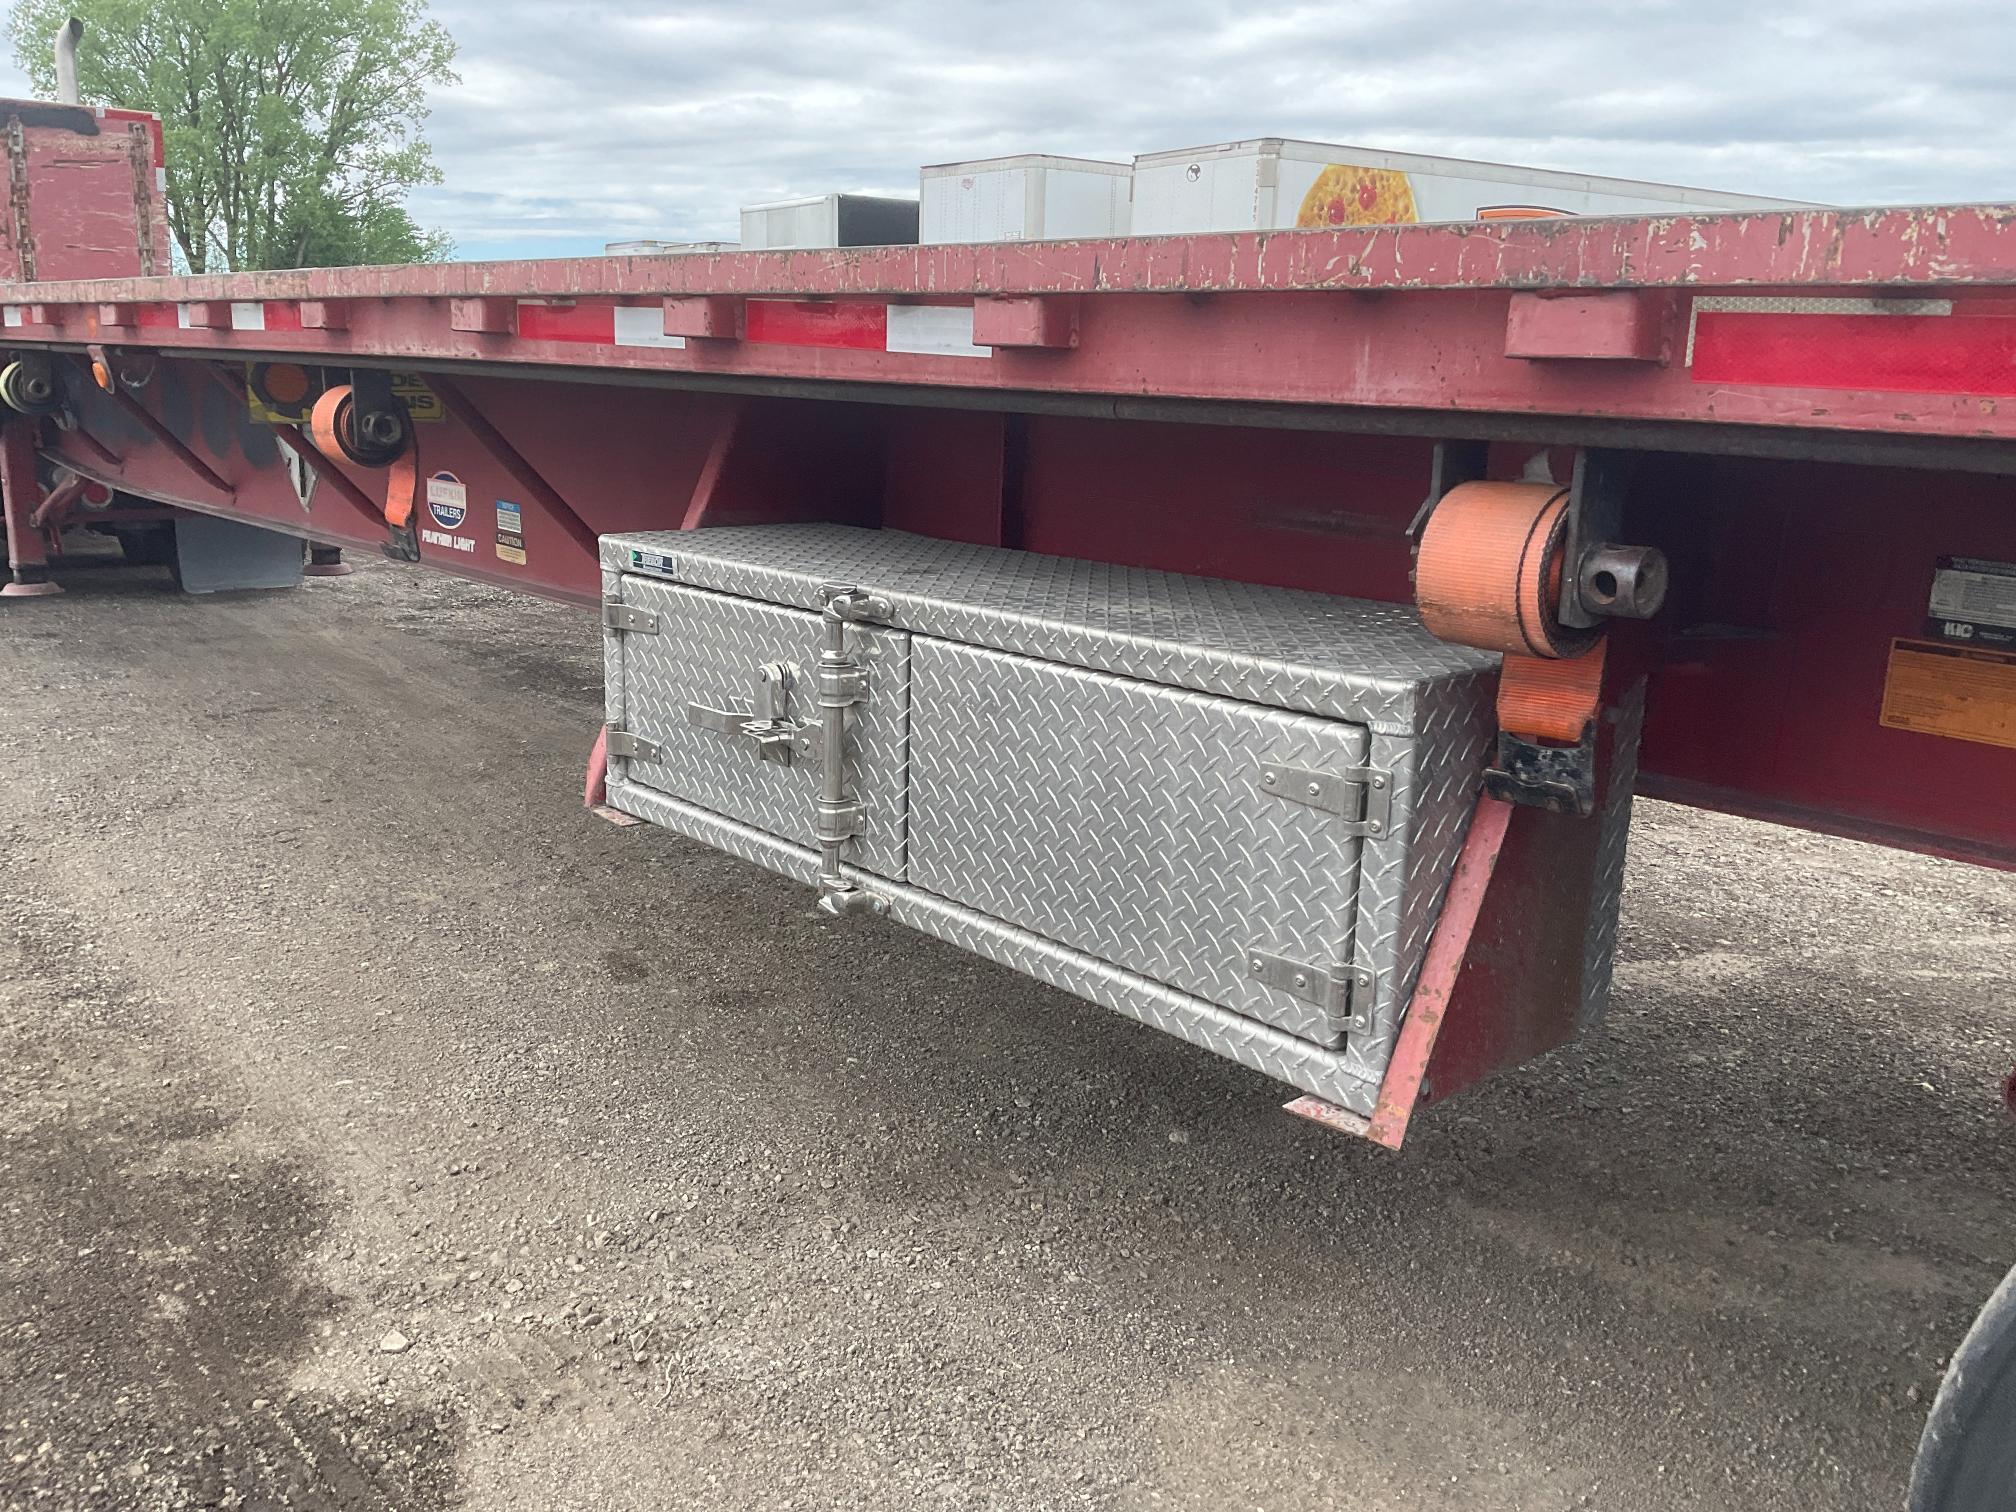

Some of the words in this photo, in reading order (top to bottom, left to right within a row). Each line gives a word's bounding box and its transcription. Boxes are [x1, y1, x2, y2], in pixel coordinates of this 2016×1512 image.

[432, 504, 462, 520] TRAILERS
[453, 536, 476, 552] LIGHT
[498, 534, 522, 547] CAUTION
